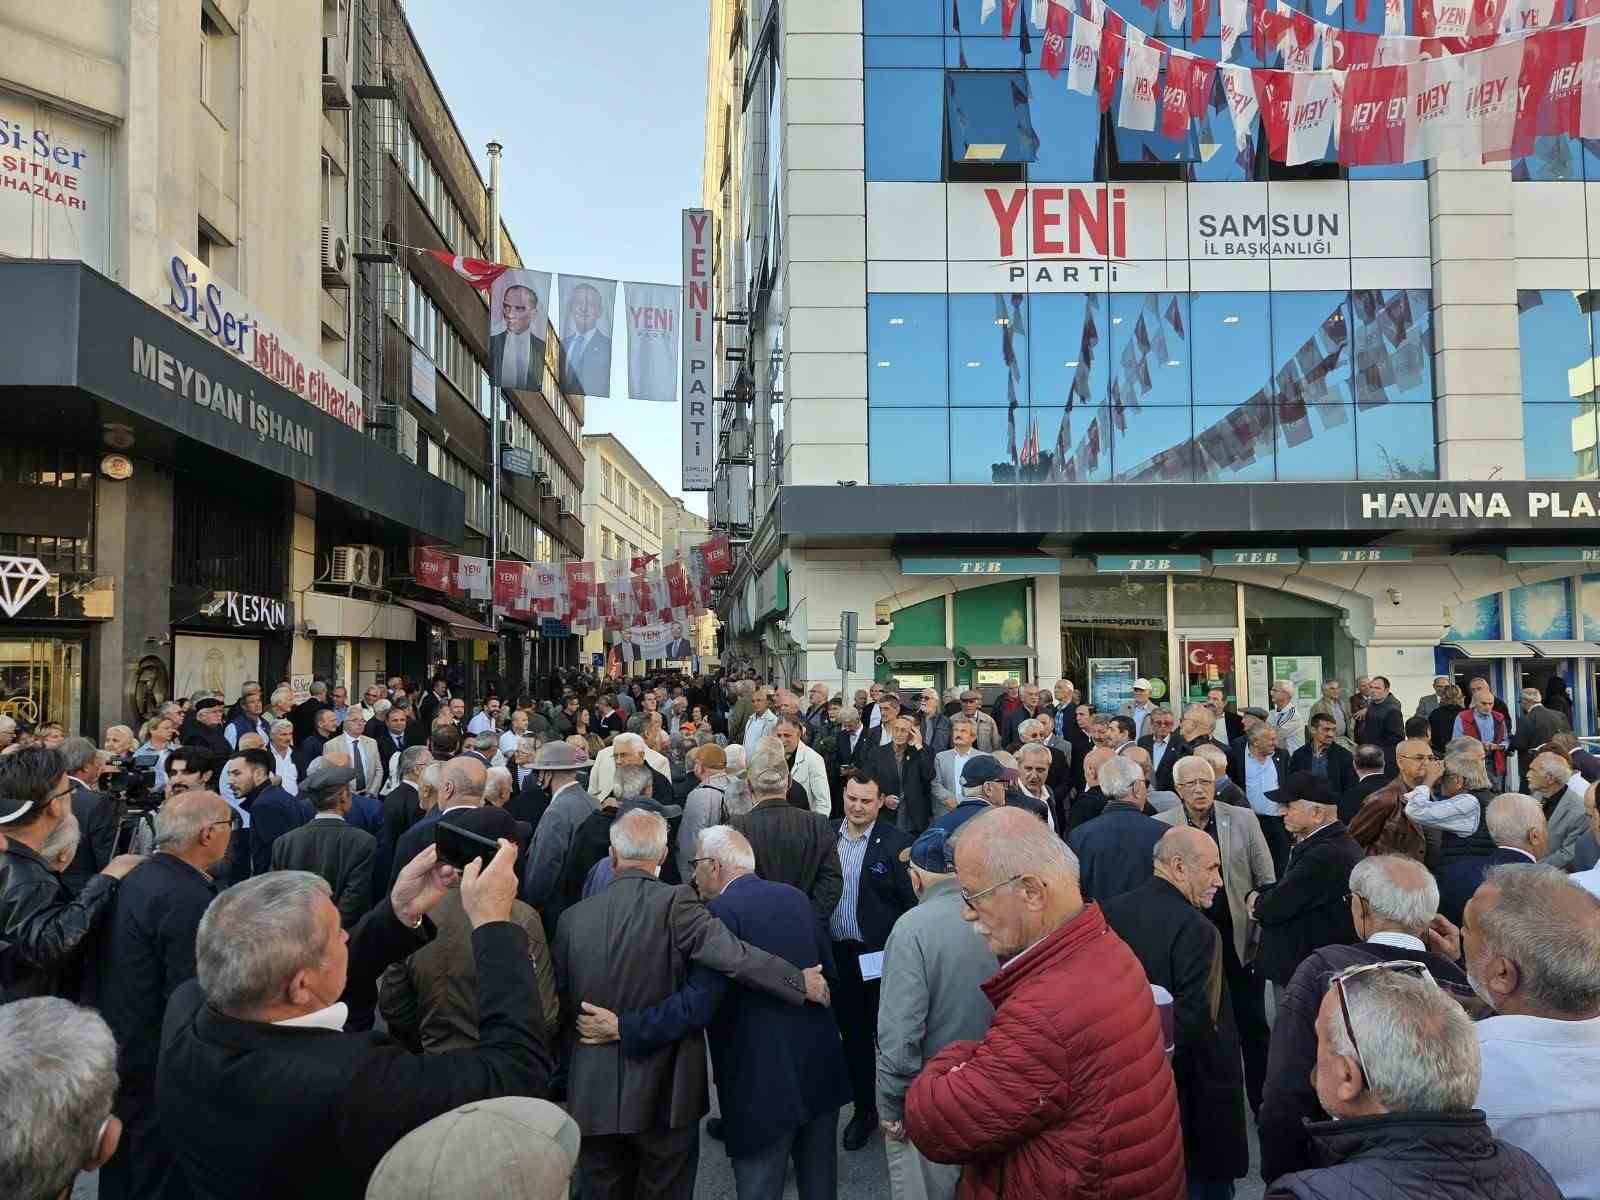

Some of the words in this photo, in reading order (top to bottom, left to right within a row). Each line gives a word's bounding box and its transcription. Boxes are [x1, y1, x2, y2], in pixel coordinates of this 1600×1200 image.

[1199, 213, 1339, 237] SAMSUN
[1204, 240, 1219, 255] İL
[1225, 239, 1331, 257] BAŞKANLIĞI
[132, 336, 243, 424] MEYDAN
[1362, 492, 1512, 518] HAVANA
[1528, 492, 1600, 518] PLA
[1233, 552, 1277, 563] TEB
[1340, 549, 1380, 561] TEB
[960, 560, 1000, 573] TEB
[1128, 559, 1171, 570] TEB
